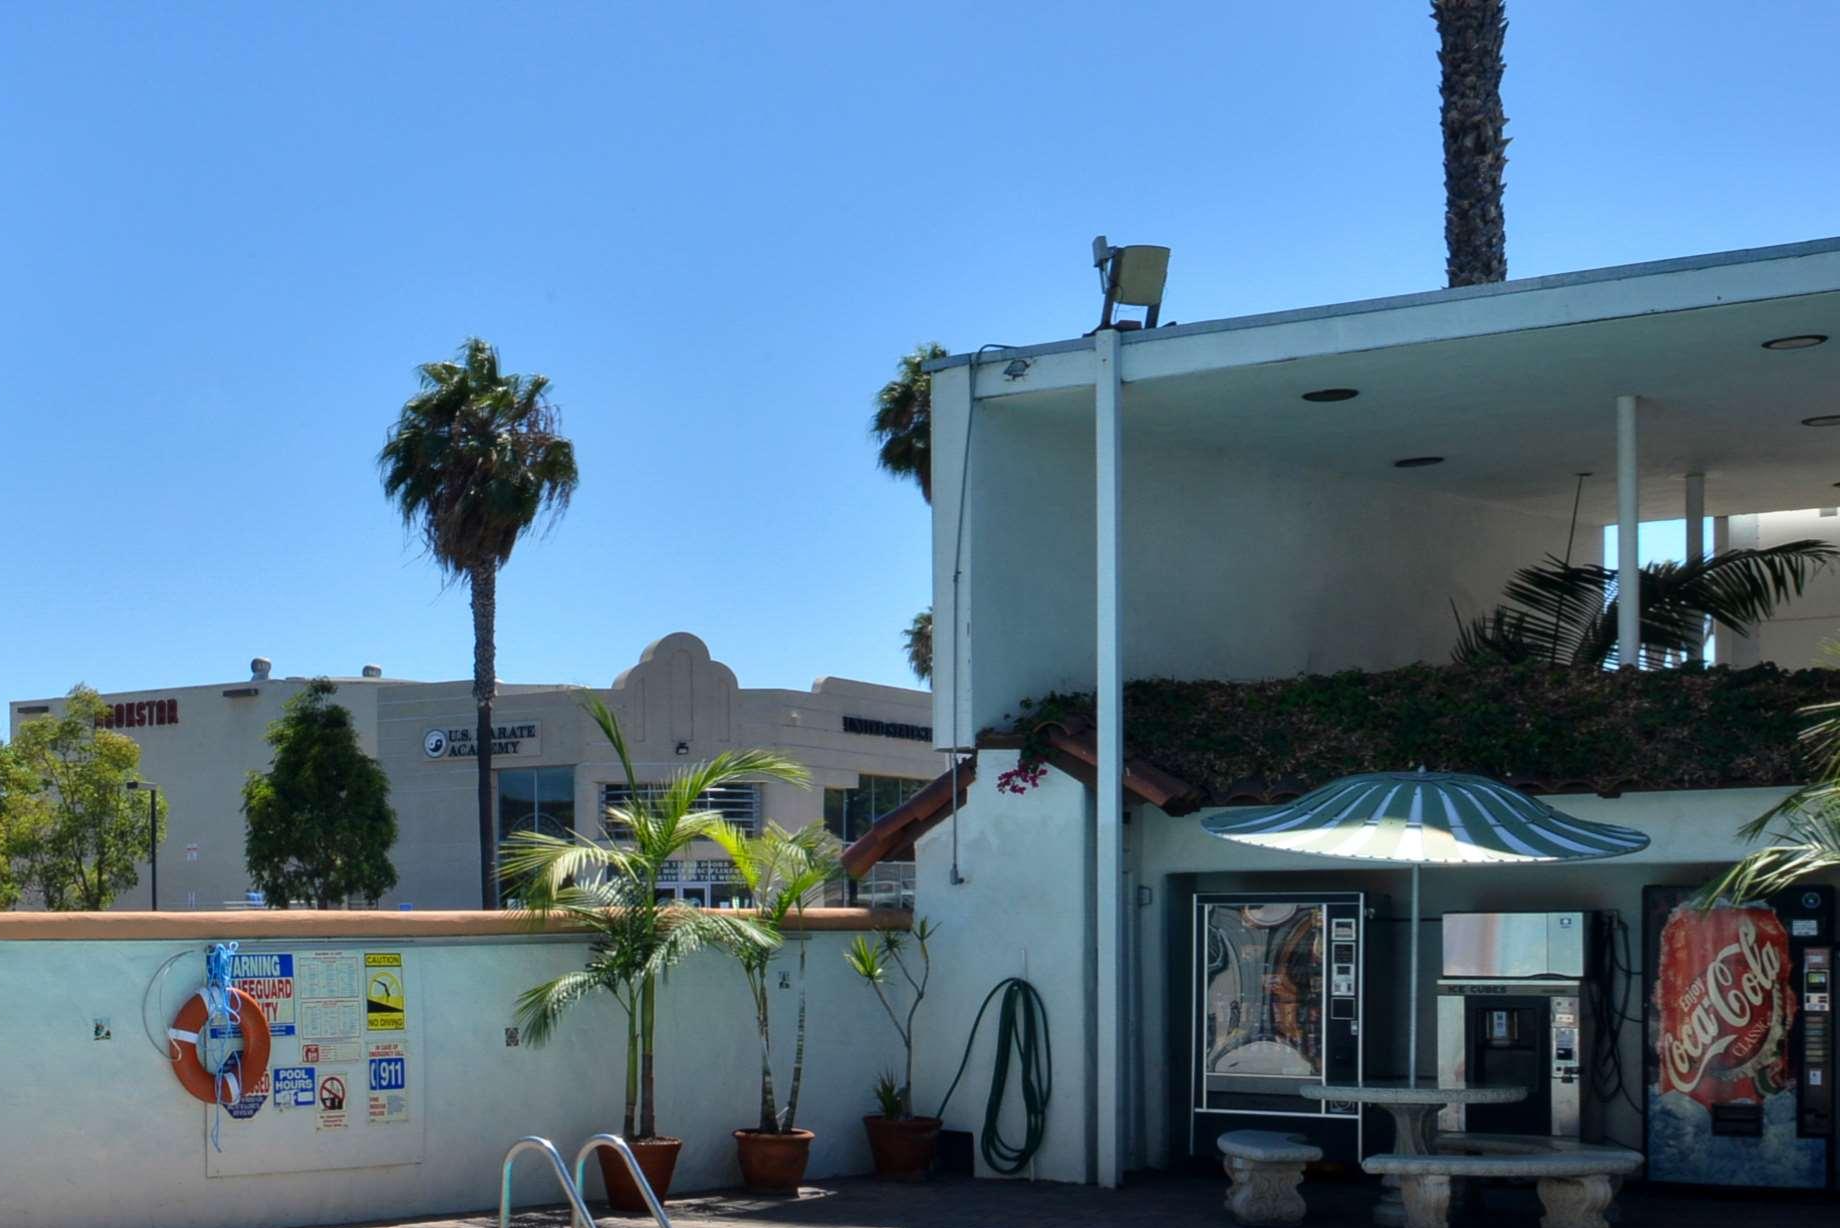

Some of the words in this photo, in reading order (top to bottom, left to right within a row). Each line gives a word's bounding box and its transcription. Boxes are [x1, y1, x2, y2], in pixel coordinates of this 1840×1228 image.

[448, 729, 472, 742] U.S.
[478, 725, 536, 741] ARATE
[448, 741, 520, 757] ACAEMY
[230, 955, 280, 977] ARNING
[1664, 918, 1781, 1093] Coca-Cola
[279, 1069, 309, 1080] POOL
[380, 1061, 403, 1087] 911
[275, 1079, 313, 1091] HOURS
